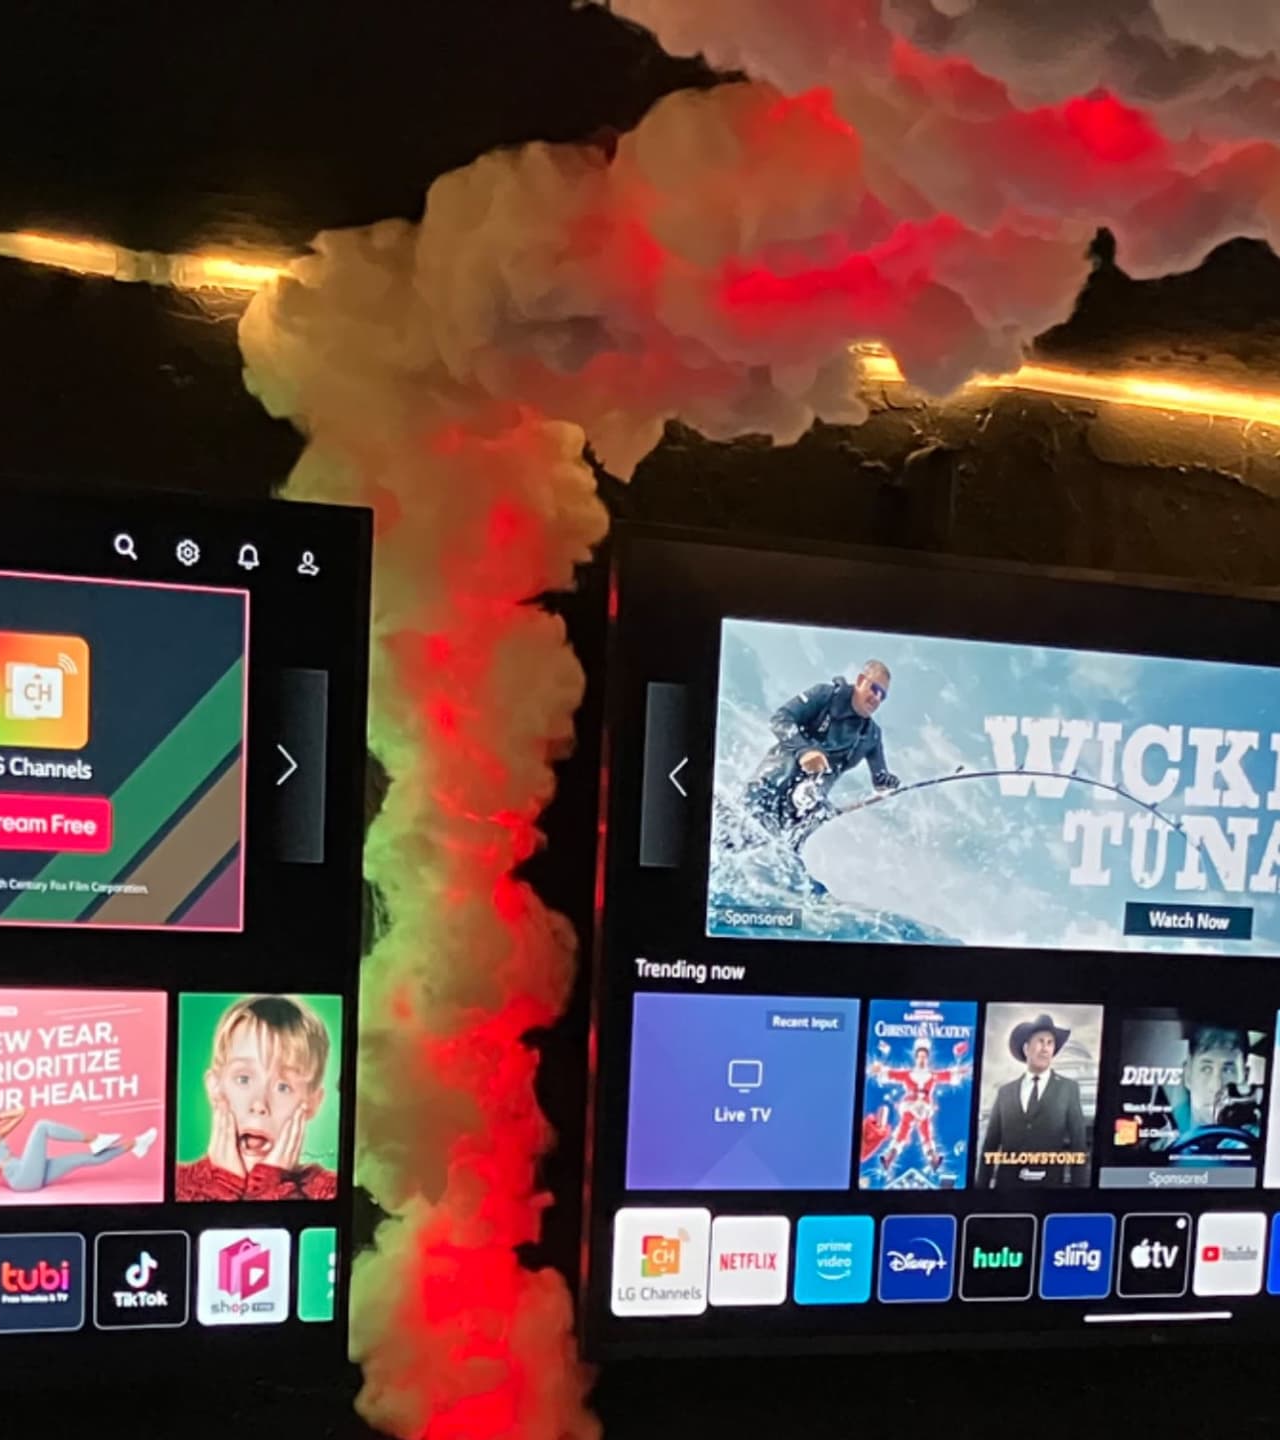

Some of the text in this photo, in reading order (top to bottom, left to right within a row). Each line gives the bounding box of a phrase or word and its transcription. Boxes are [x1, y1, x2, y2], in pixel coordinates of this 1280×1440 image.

[24, 683, 52, 702] CH
[10, 757, 92, 780] Channels
[51, 814, 97, 836] Free
[9, 879, 47, 893] Century
[50, 880, 67, 891] Fox
[69, 881, 89, 892] Film
[725, 909, 793, 929] Sponsored
[1150, 911, 1230, 930] Watch Now
[635, 958, 745, 983] Trending now
[773, 1016, 839, 1031] Recent Input
[1120, 1065, 1183, 1085] DRIVE
[30, 1074, 138, 1108] HEALTH
[714, 1107, 772, 1123] Live TV
[984, 1152, 1086, 1164] YELLOWSTONE
[1148, 1171, 1209, 1187] Sponsored
[817, 1240, 852, 1253] prime
[1151, 1241, 1178, 1268] tv
[652, 1249, 675, 1264] CH
[720, 1252, 777, 1271] NETFLIX
[817, 1255, 852, 1268] video
[973, 1247, 1023, 1268] hulu
[1054, 1242, 1101, 1271] sling
[1, 1259, 69, 1292] tubi
[113, 1289, 168, 1307] TikTok
[618, 1285, 702, 1301] LG Channels
[210, 1300, 249, 1315] shop
